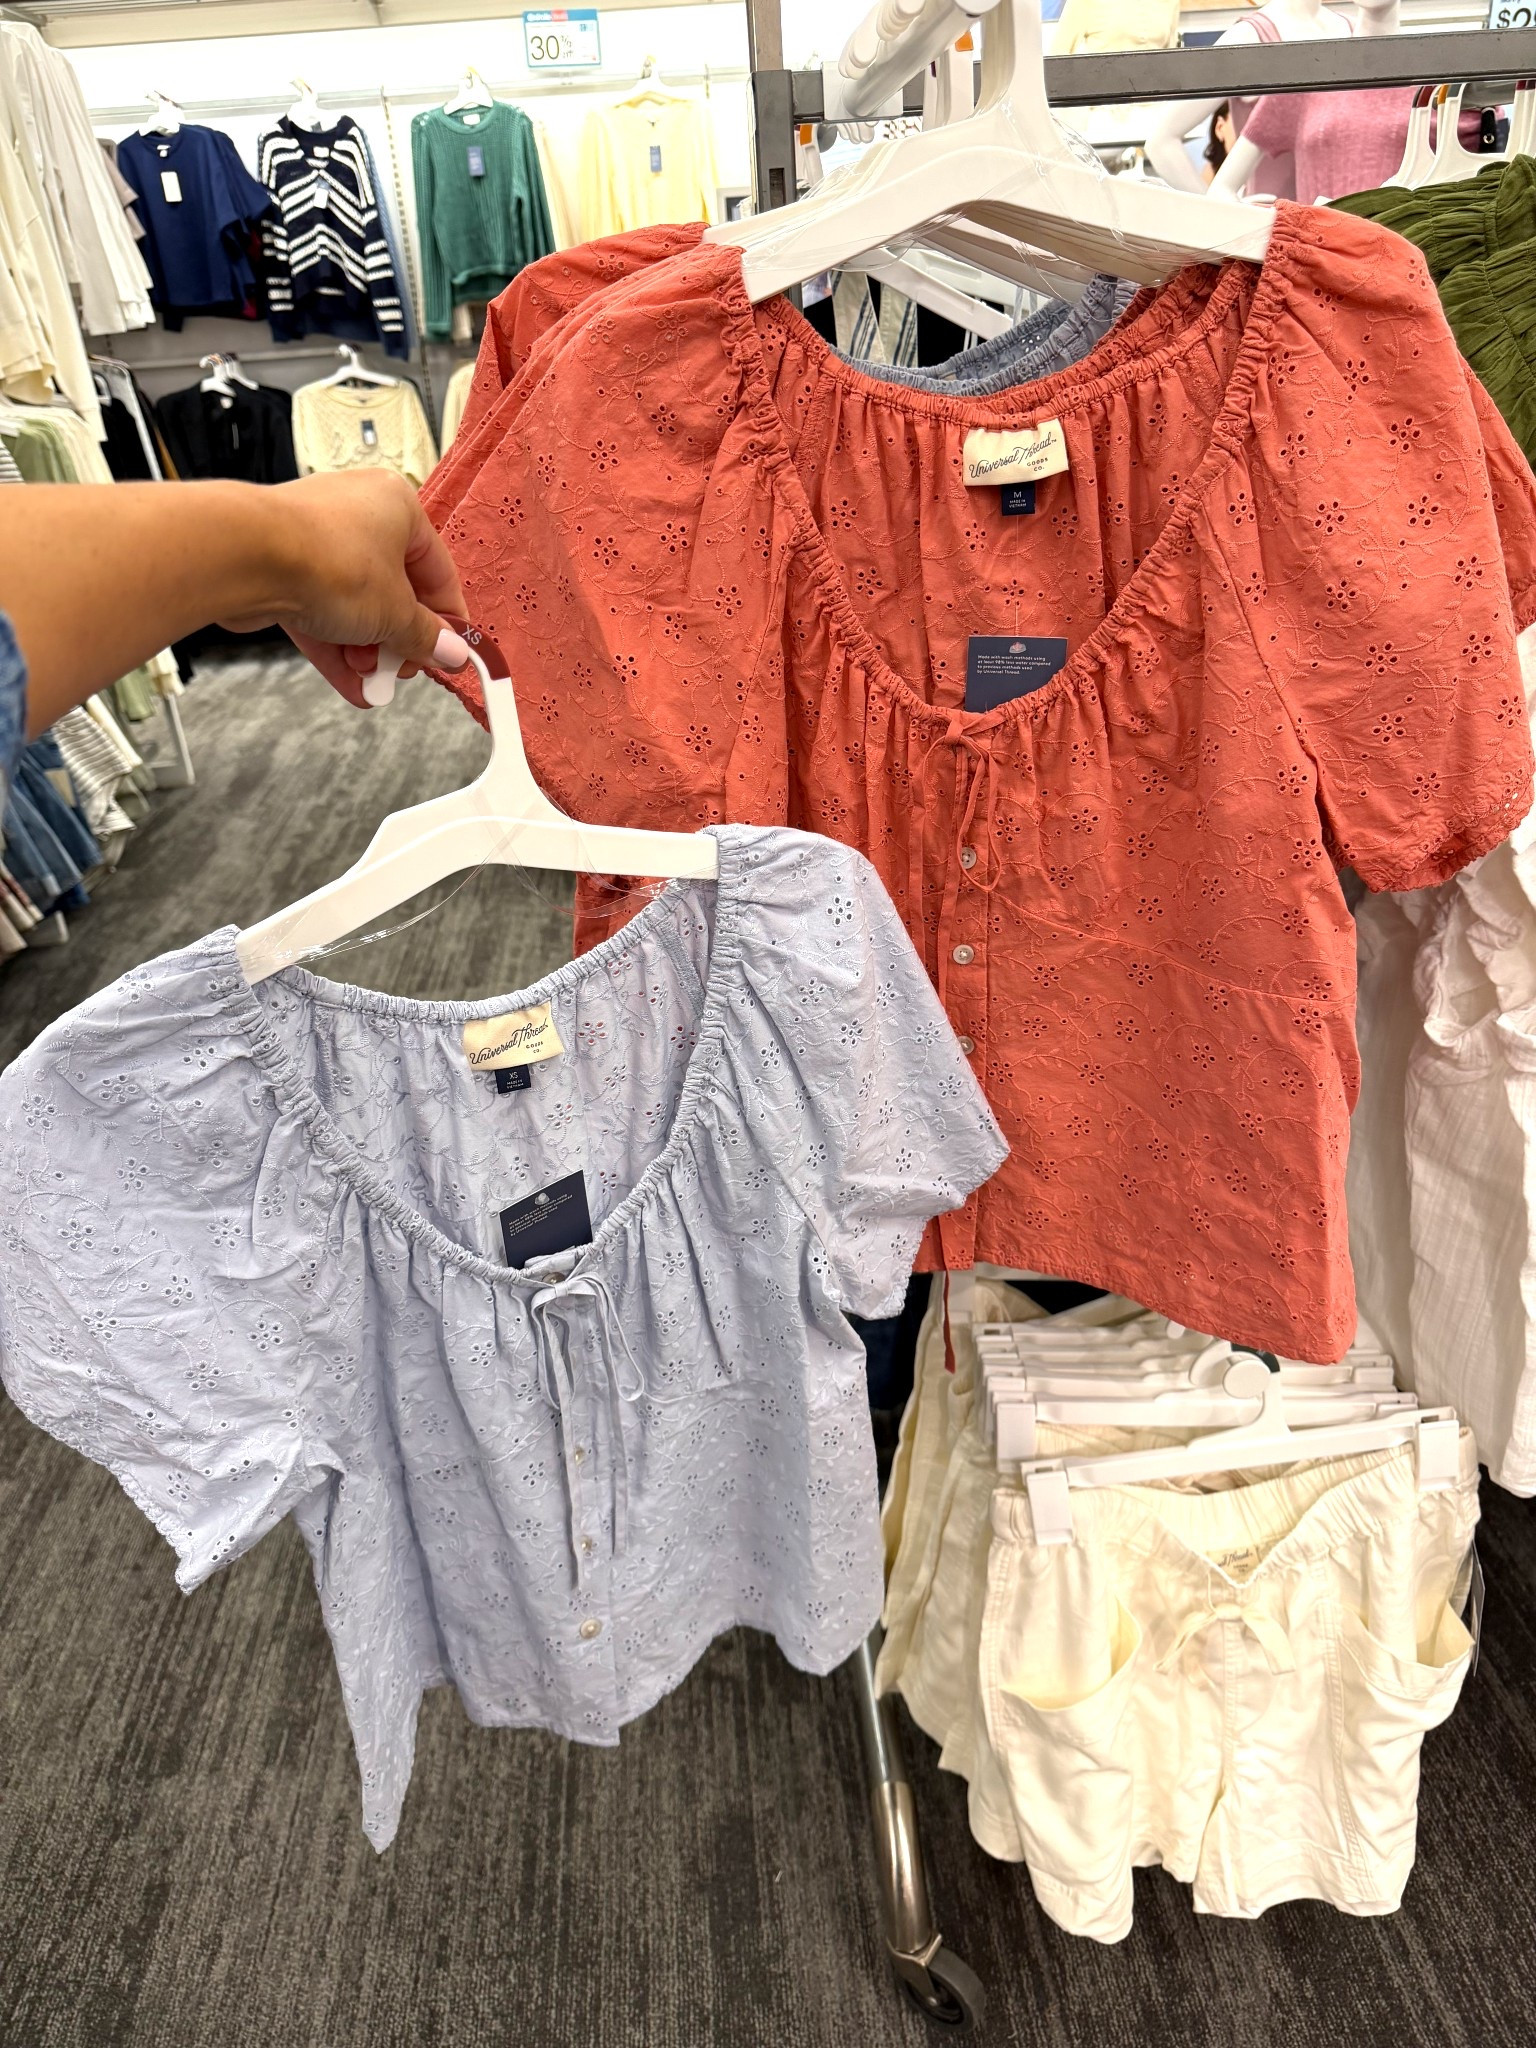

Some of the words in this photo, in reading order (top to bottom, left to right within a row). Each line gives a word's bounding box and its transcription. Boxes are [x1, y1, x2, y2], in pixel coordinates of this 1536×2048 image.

[969, 449, 1019, 478] Universal
[1027, 457, 1049, 467] GOODS
[1013, 491, 1022, 499] M
[462, 624, 483, 645] XS
[470, 1033, 518, 1064] Universal
[508, 1071, 519, 1080] XS
